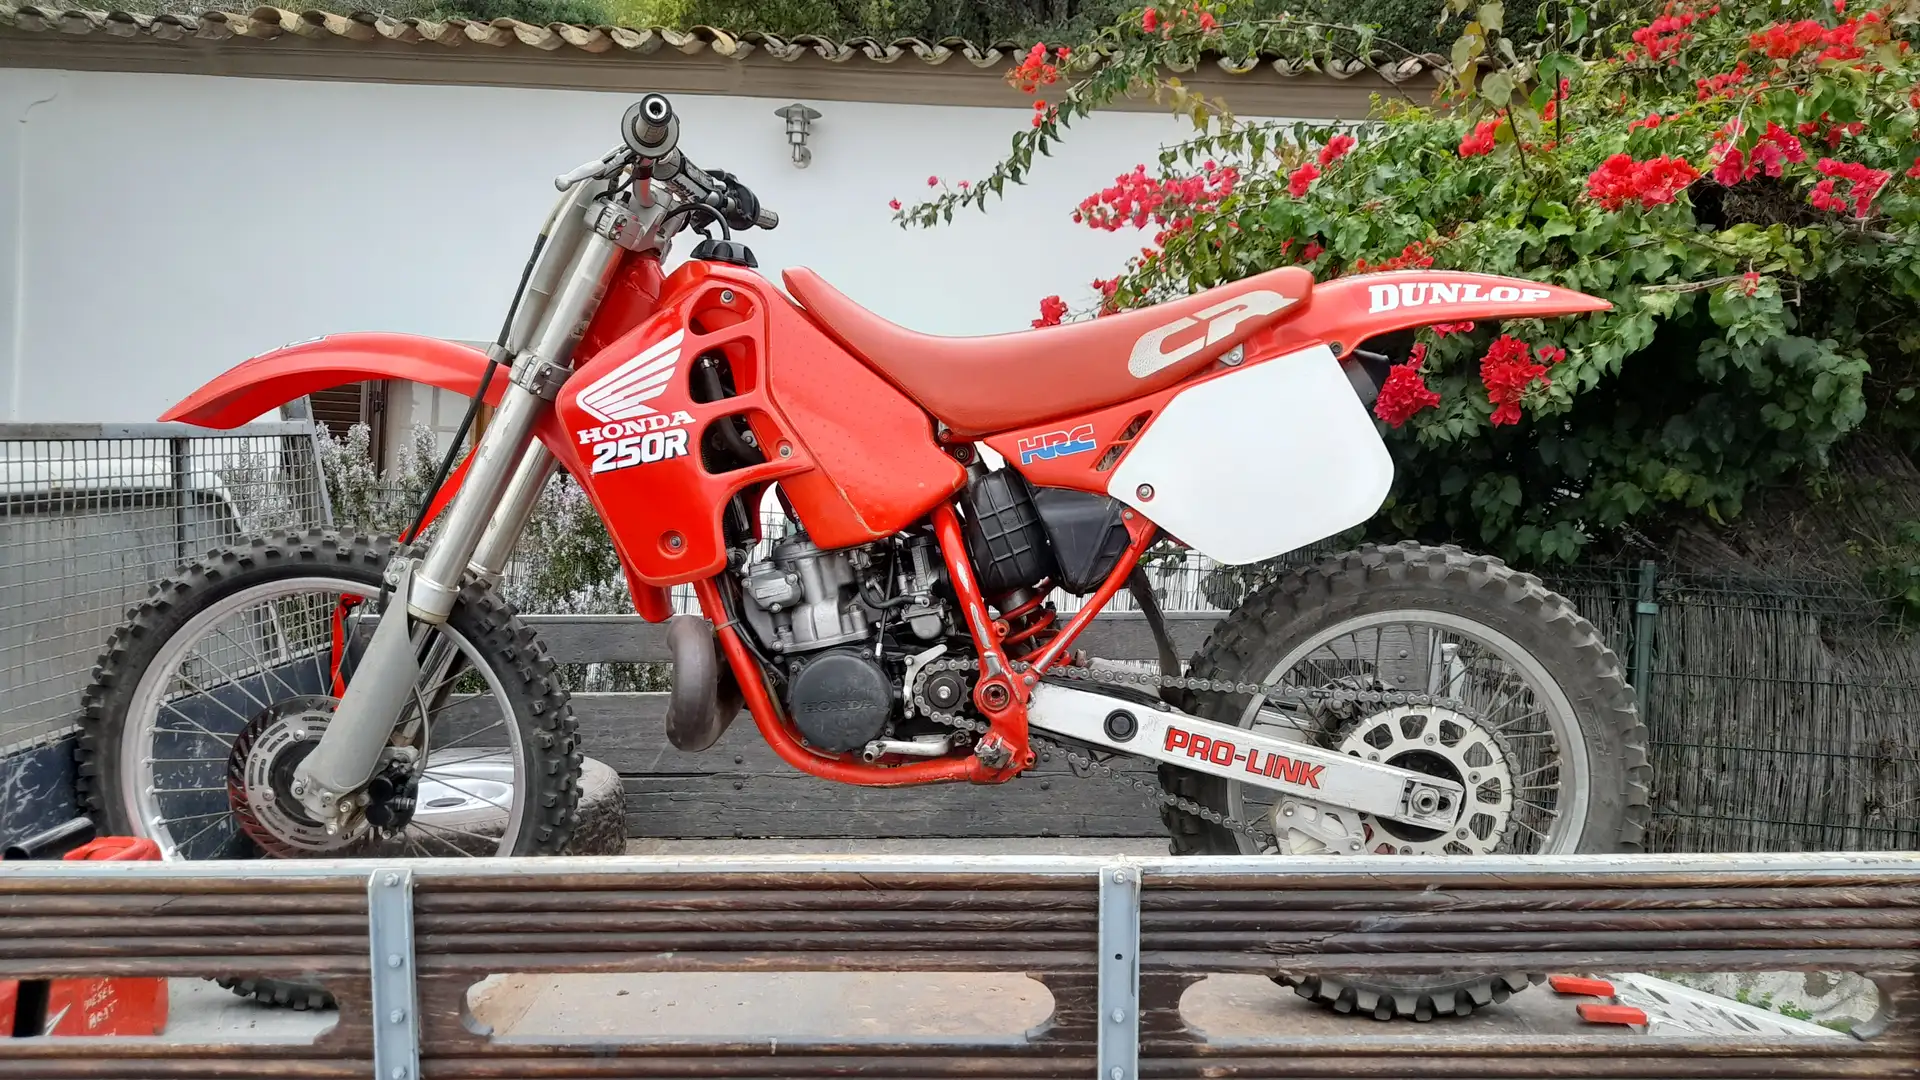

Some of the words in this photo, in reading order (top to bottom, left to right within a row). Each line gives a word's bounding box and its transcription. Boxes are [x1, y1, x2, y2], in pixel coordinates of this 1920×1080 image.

[1368, 282, 1550, 314] DUNLOP
[1128, 290, 1299, 378] CR
[576, 410, 697, 445] HONDA
[1018, 423, 1097, 465] HRC
[591, 428, 690, 475] 250R
[802, 699, 878, 713] HONDA
[1164, 727, 1326, 790] PRO-LINK
